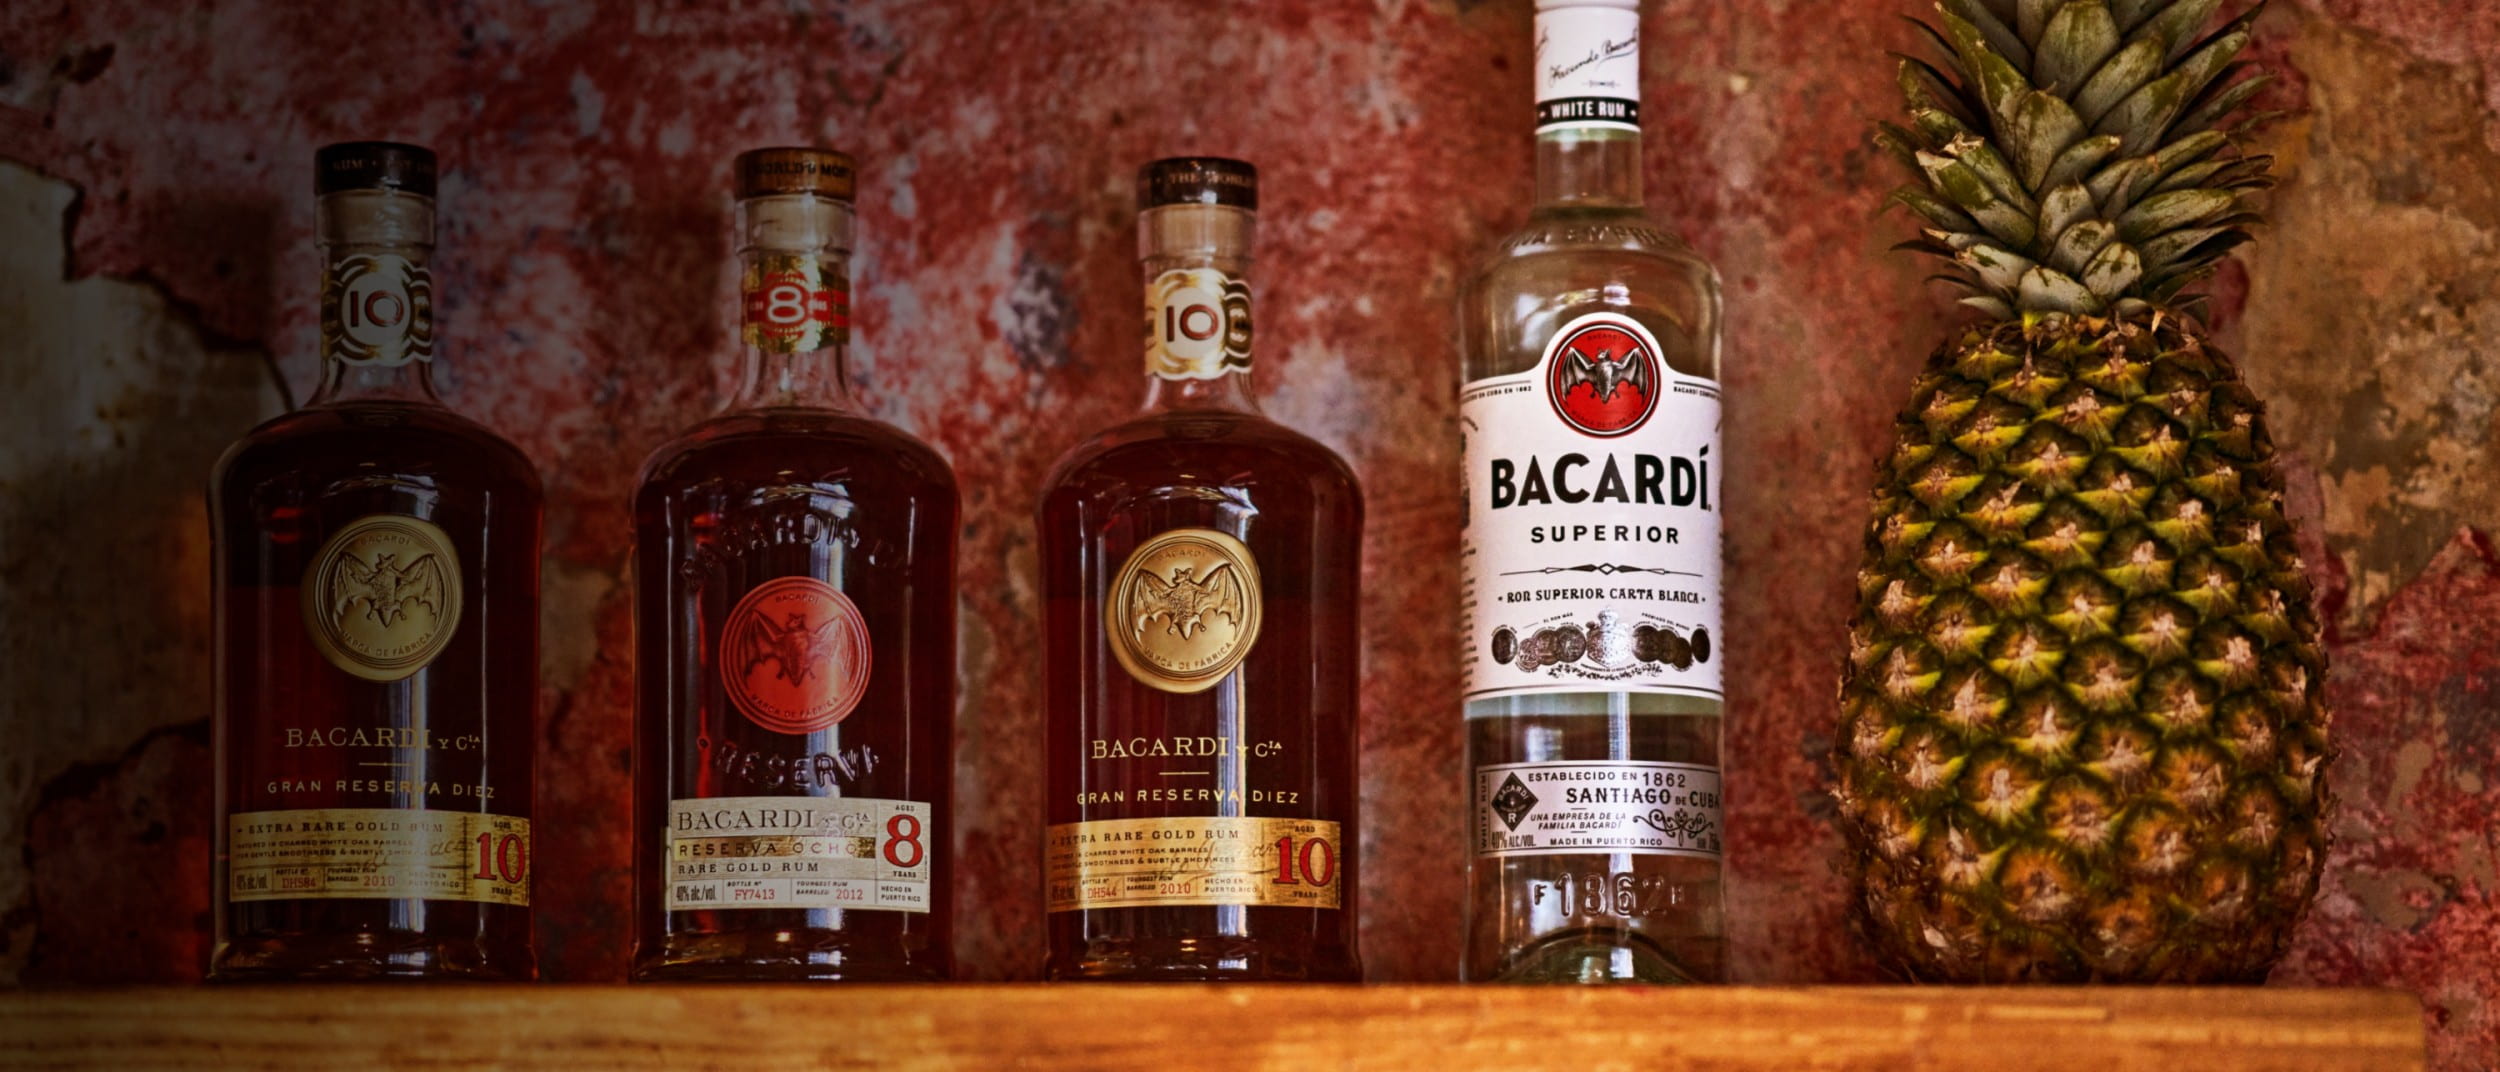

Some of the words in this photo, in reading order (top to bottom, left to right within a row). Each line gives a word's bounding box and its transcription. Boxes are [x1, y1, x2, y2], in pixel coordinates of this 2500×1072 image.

[1551, 101, 1594, 118] WHITE
[1598, 101, 1625, 117] RUM
[350, 290, 404, 328] 10
[767, 285, 805, 324] 8
[1166, 304, 1219, 342] 10
[1491, 444, 1709, 510] BACARDÍ
[1531, 525, 1679, 544] SUPERIOR
[1507, 591, 1531, 603] RON
[1536, 588, 1605, 602] SUPERIOR
[1609, 587, 1654, 601] CARTA
[1658, 590, 1699, 604] BLANCA
[284, 727, 432, 749] BACARDI
[1091, 737, 1230, 760] BACARDI
[1528, 771, 1616, 782] ESTABLECIDO
[1622, 771, 1638, 781] EN
[1642, 771, 1687, 788] 1862
[267, 780, 321, 795] GRAN
[335, 780, 441, 796] RESERVA
[452, 783, 496, 799] DIEZ
[1076, 790, 1125, 806] GRAN
[1137, 788, 1240, 803] RESERVA
[1252, 789, 1299, 804] DIEZ
[1565, 787, 1671, 805] SANTIAGO
[1675, 796, 1687, 806] DE
[678, 809, 816, 831] BACARDI
[1507, 812, 1518, 823] R
[1530, 814, 1549, 822] UNA
[1551, 812, 1595, 821] EMPRESA
[1599, 812, 1612, 820] DE
[1615, 812, 1627, 820] LA
[248, 822, 293, 835] EXTRA
[302, 822, 346, 832] RARE
[356, 821, 400, 832] GOLD
[409, 823, 442, 833] RUM
[1538, 821, 1576, 831] FAMILIA
[883, 813, 924, 868] 8
[1060, 833, 1096, 846] EXTRA
[1104, 831, 1143, 842] RARE
[1152, 829, 1195, 840] GOLD
[1205, 829, 1239, 839] RUM
[1549, 838, 1578, 846] MADE
[1582, 837, 1594, 845] IN
[1596, 837, 1637, 846] PUERTO
[1640, 837, 1664, 846] RICO
[474, 832, 526, 884] 10
[679, 843, 777, 857] RESERVA
[792, 842, 858, 855] OCHO
[678, 864, 717, 876] RARE
[727, 862, 771, 873] GOLD
[782, 862, 819, 873] RUM
[1137, 857, 1145, 865] &
[1272, 836, 1336, 888] 10
[363, 875, 396, 887] 2010
[893, 870, 917, 879] YEARS
[735, 889, 776, 901] FY7413
[836, 888, 864, 901] 2012
[1160, 882, 1191, 895] 2010
[881, 894, 906, 902] PUERTO
